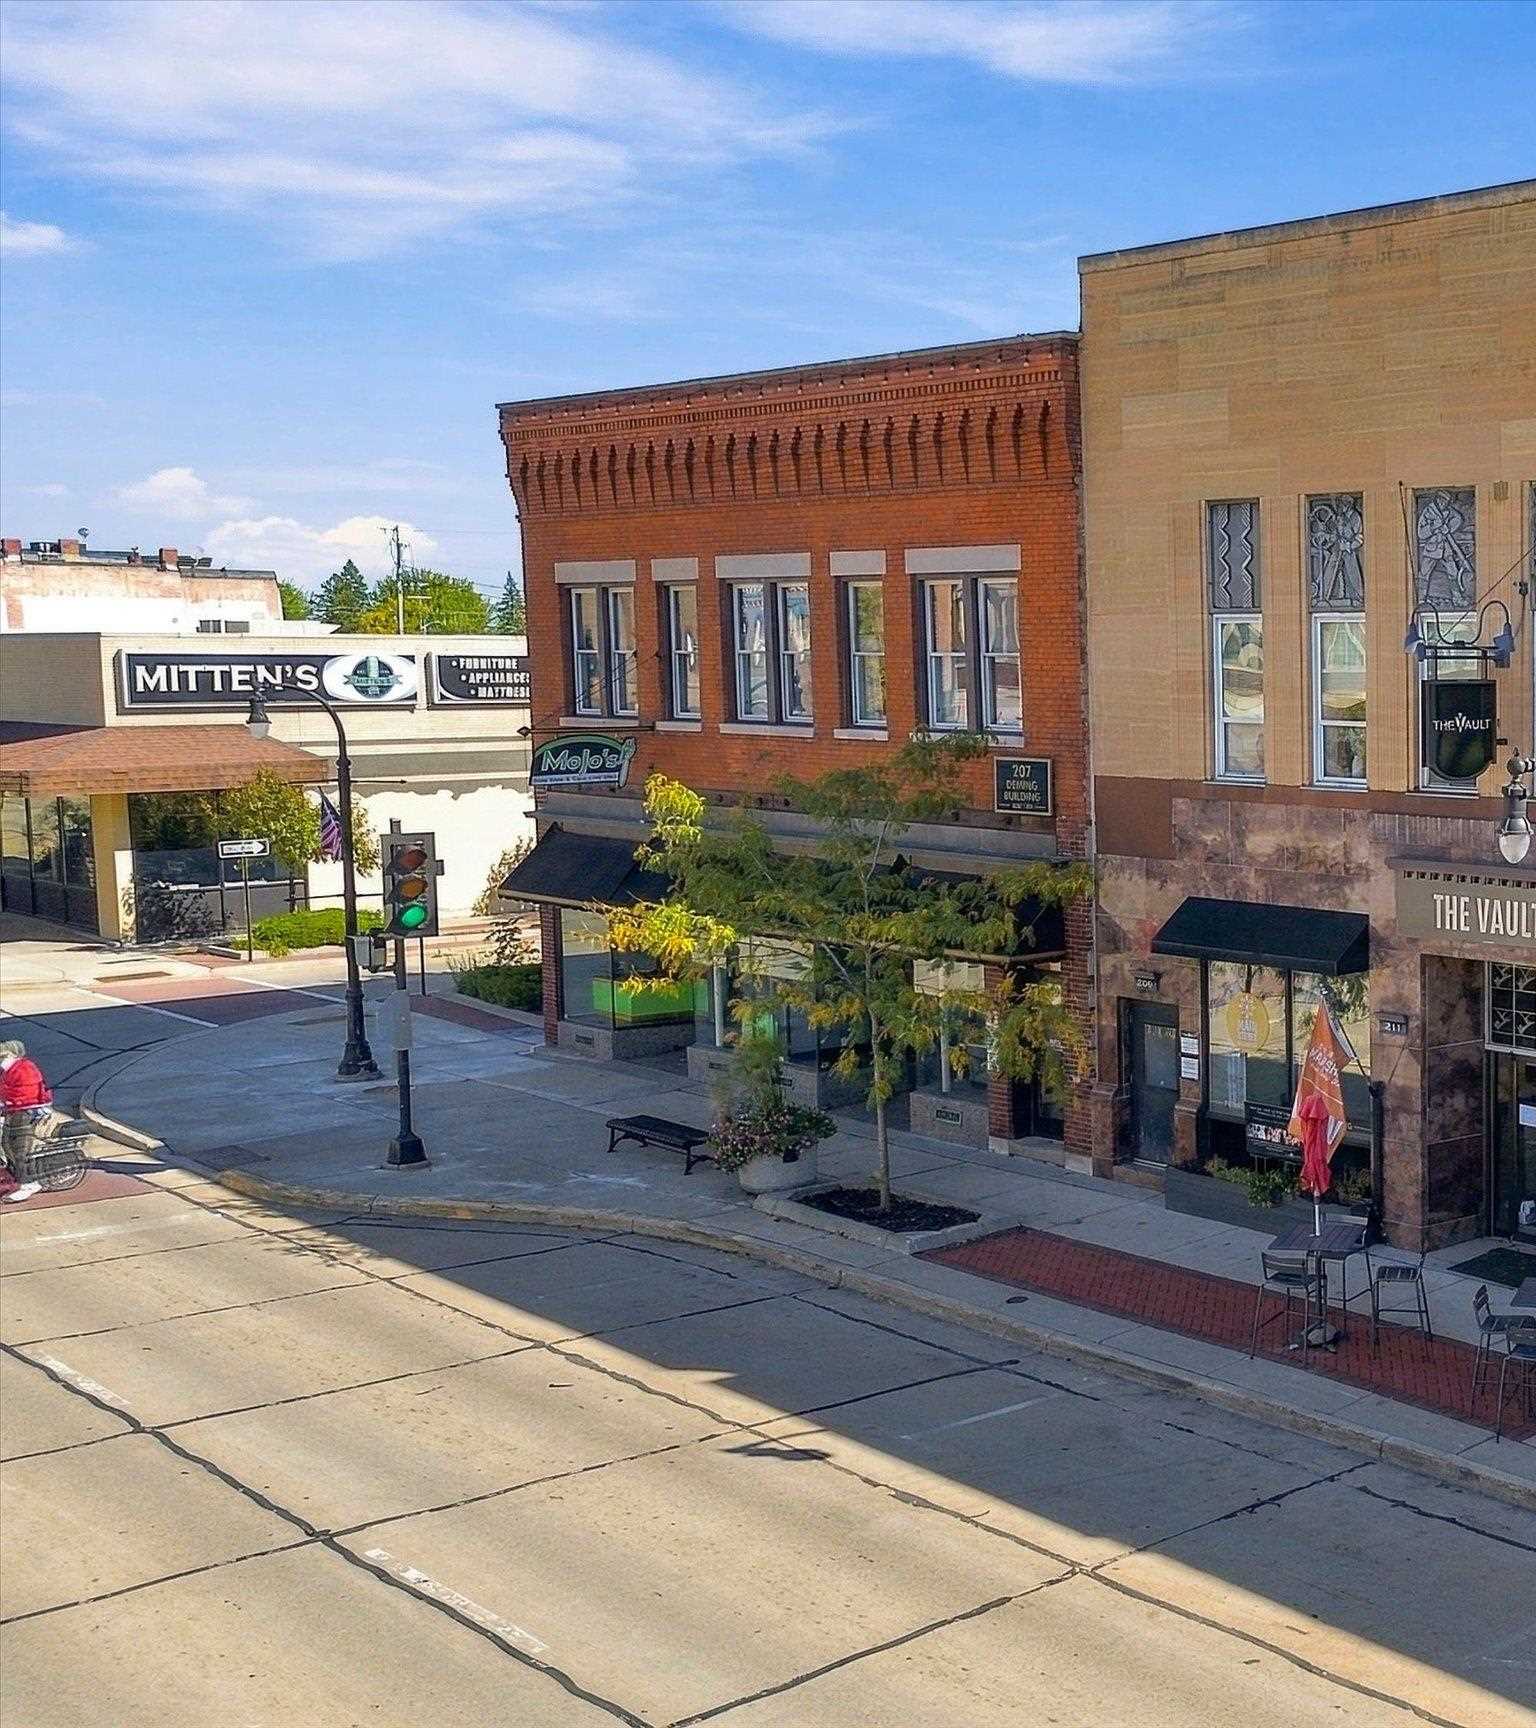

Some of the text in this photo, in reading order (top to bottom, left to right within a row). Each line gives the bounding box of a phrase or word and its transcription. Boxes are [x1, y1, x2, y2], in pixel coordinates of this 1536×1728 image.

[459, 658, 518, 669] FURNITURE
[135, 664, 320, 692] MITTEN'S
[1432, 712, 1491, 733] THE VAULT
[1012, 764, 1031, 778] 207
[1433, 893, 1470, 932] THE
